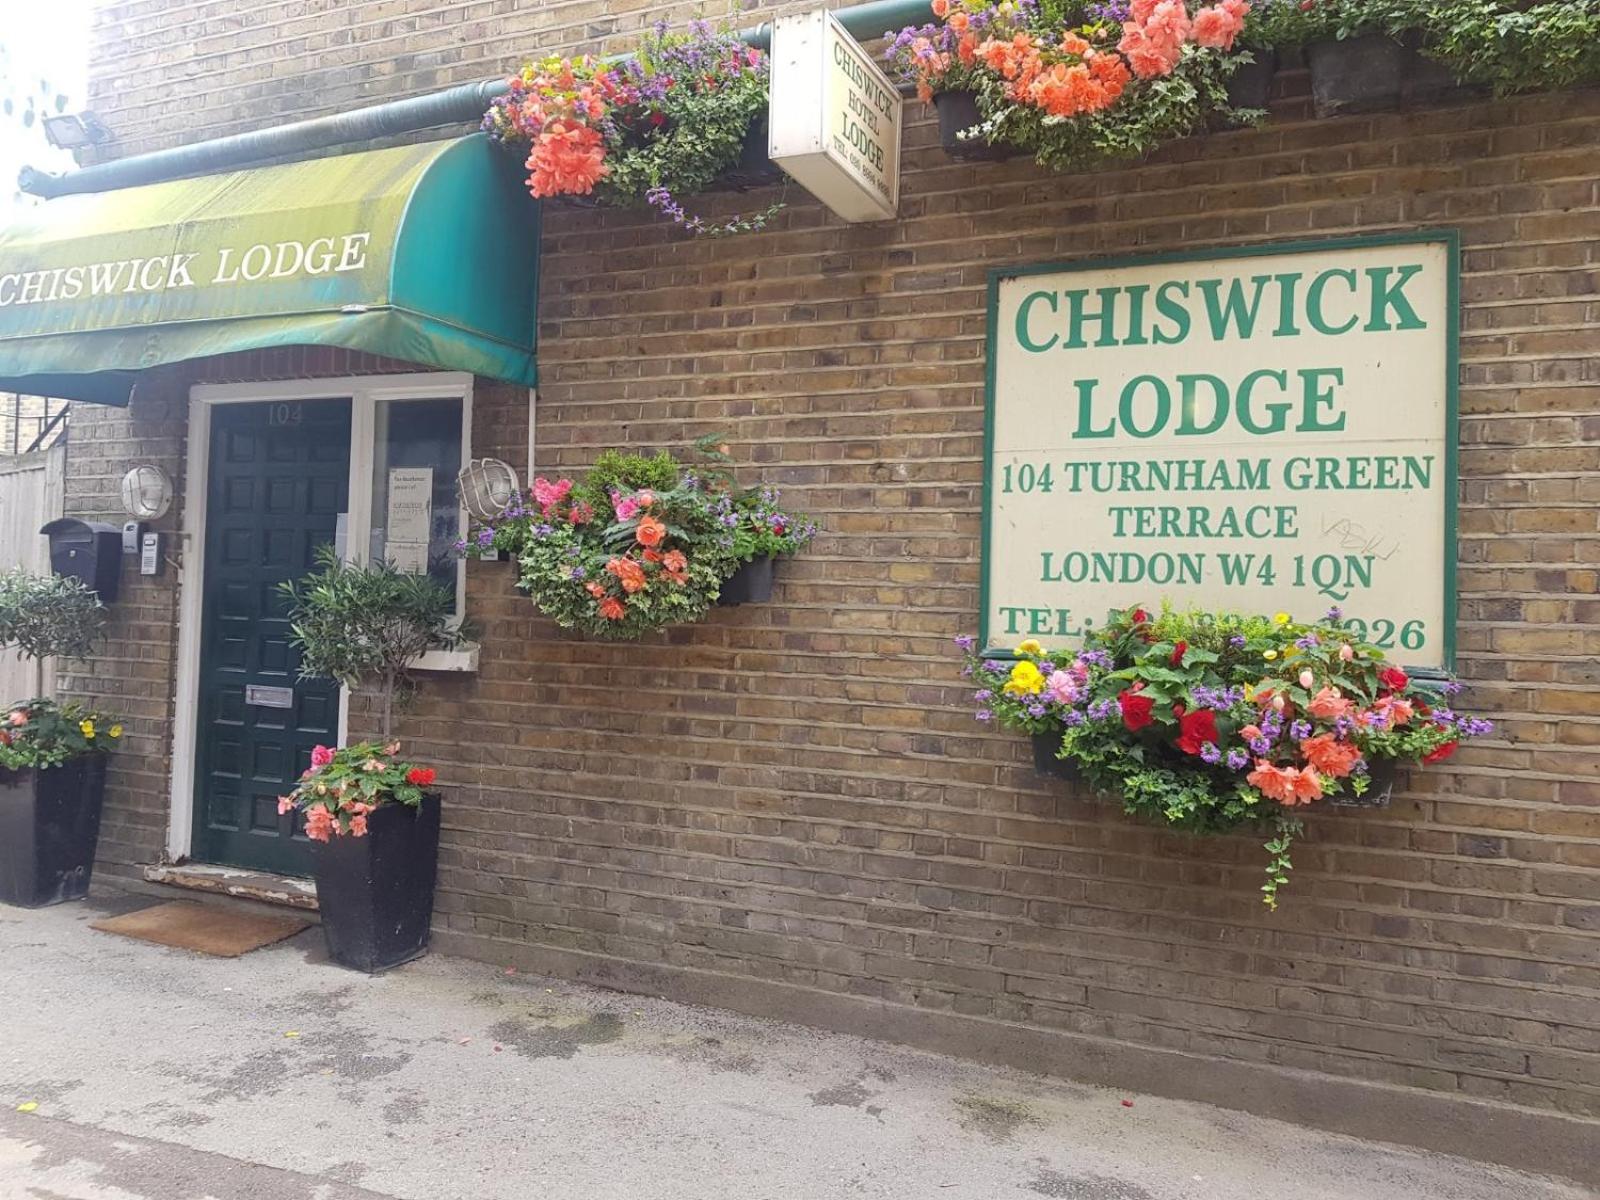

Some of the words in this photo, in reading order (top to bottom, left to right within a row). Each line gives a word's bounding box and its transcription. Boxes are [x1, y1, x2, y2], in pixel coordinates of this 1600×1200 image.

[833, 41, 894, 122] CHISWICK
[848, 88, 880, 136] HOTEL
[842, 112, 884, 173] LODGE
[0, 252, 200, 306] CHISWICK
[212, 232, 370, 284] LODGE
[1014, 264, 1428, 354] CHISWICK
[266, 403, 303, 425] 104
[1072, 367, 1347, 440] LODGE
[1001, 462, 1054, 493] 104
[1064, 458, 1272, 493] TURNHAM
[1283, 455, 1435, 490] GREEN
[1108, 505, 1299, 538] TERRACE
[1040, 552, 1206, 584] LONDON
[1216, 553, 1276, 586] W4
[1292, 554, 1375, 601] 1QN
[1318, 616, 1425, 650] 926
